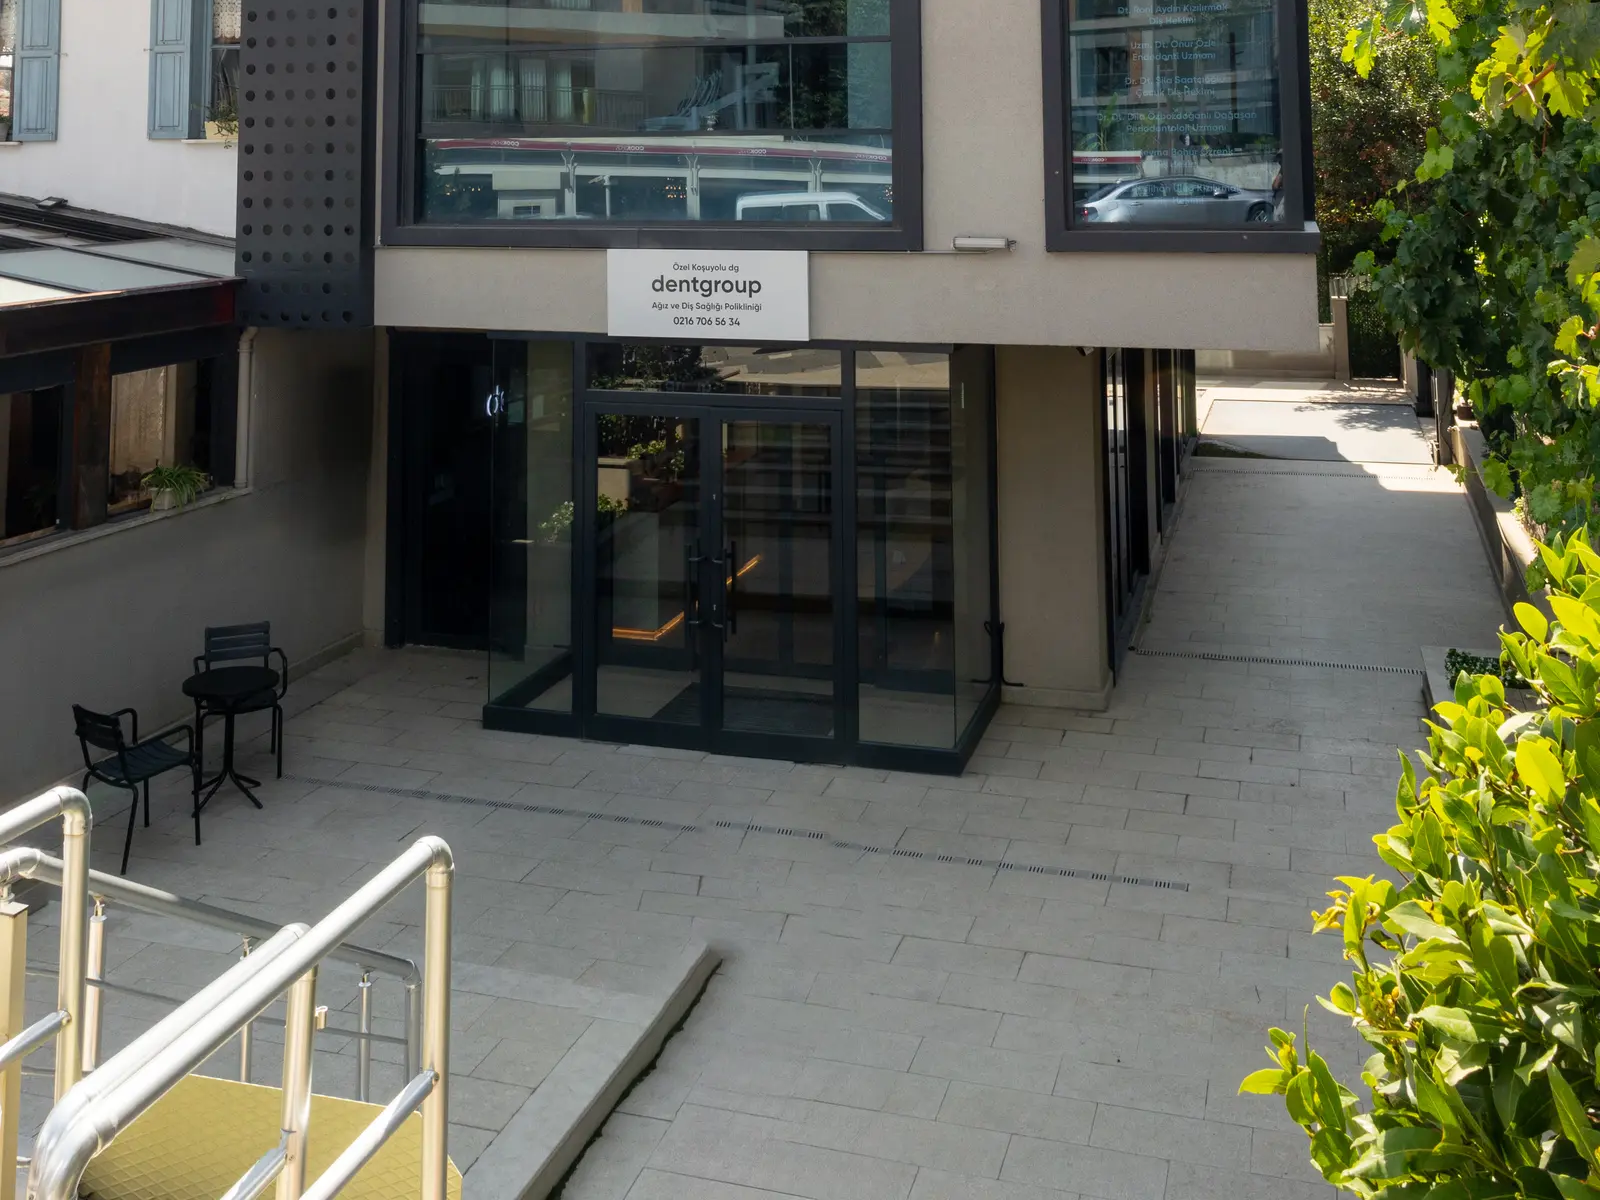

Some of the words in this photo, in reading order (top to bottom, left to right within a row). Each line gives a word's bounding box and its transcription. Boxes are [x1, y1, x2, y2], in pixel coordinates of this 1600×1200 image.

[672, 261, 690, 271] Özel
[691, 263, 726, 273] Koşuyolu
[728, 264, 739, 273] dg
[651, 275, 762, 298] dentgroup
[651, 301, 668, 311] Ağız
[681, 301, 694, 311] Diş
[695, 301, 723, 311] Sağlığı
[724, 302, 762, 312] Polikliniği
[673, 316, 694, 325] 0216
[695, 317, 713, 326] 706
[715, 317, 727, 326] 56
[728, 318, 741, 326] 34
